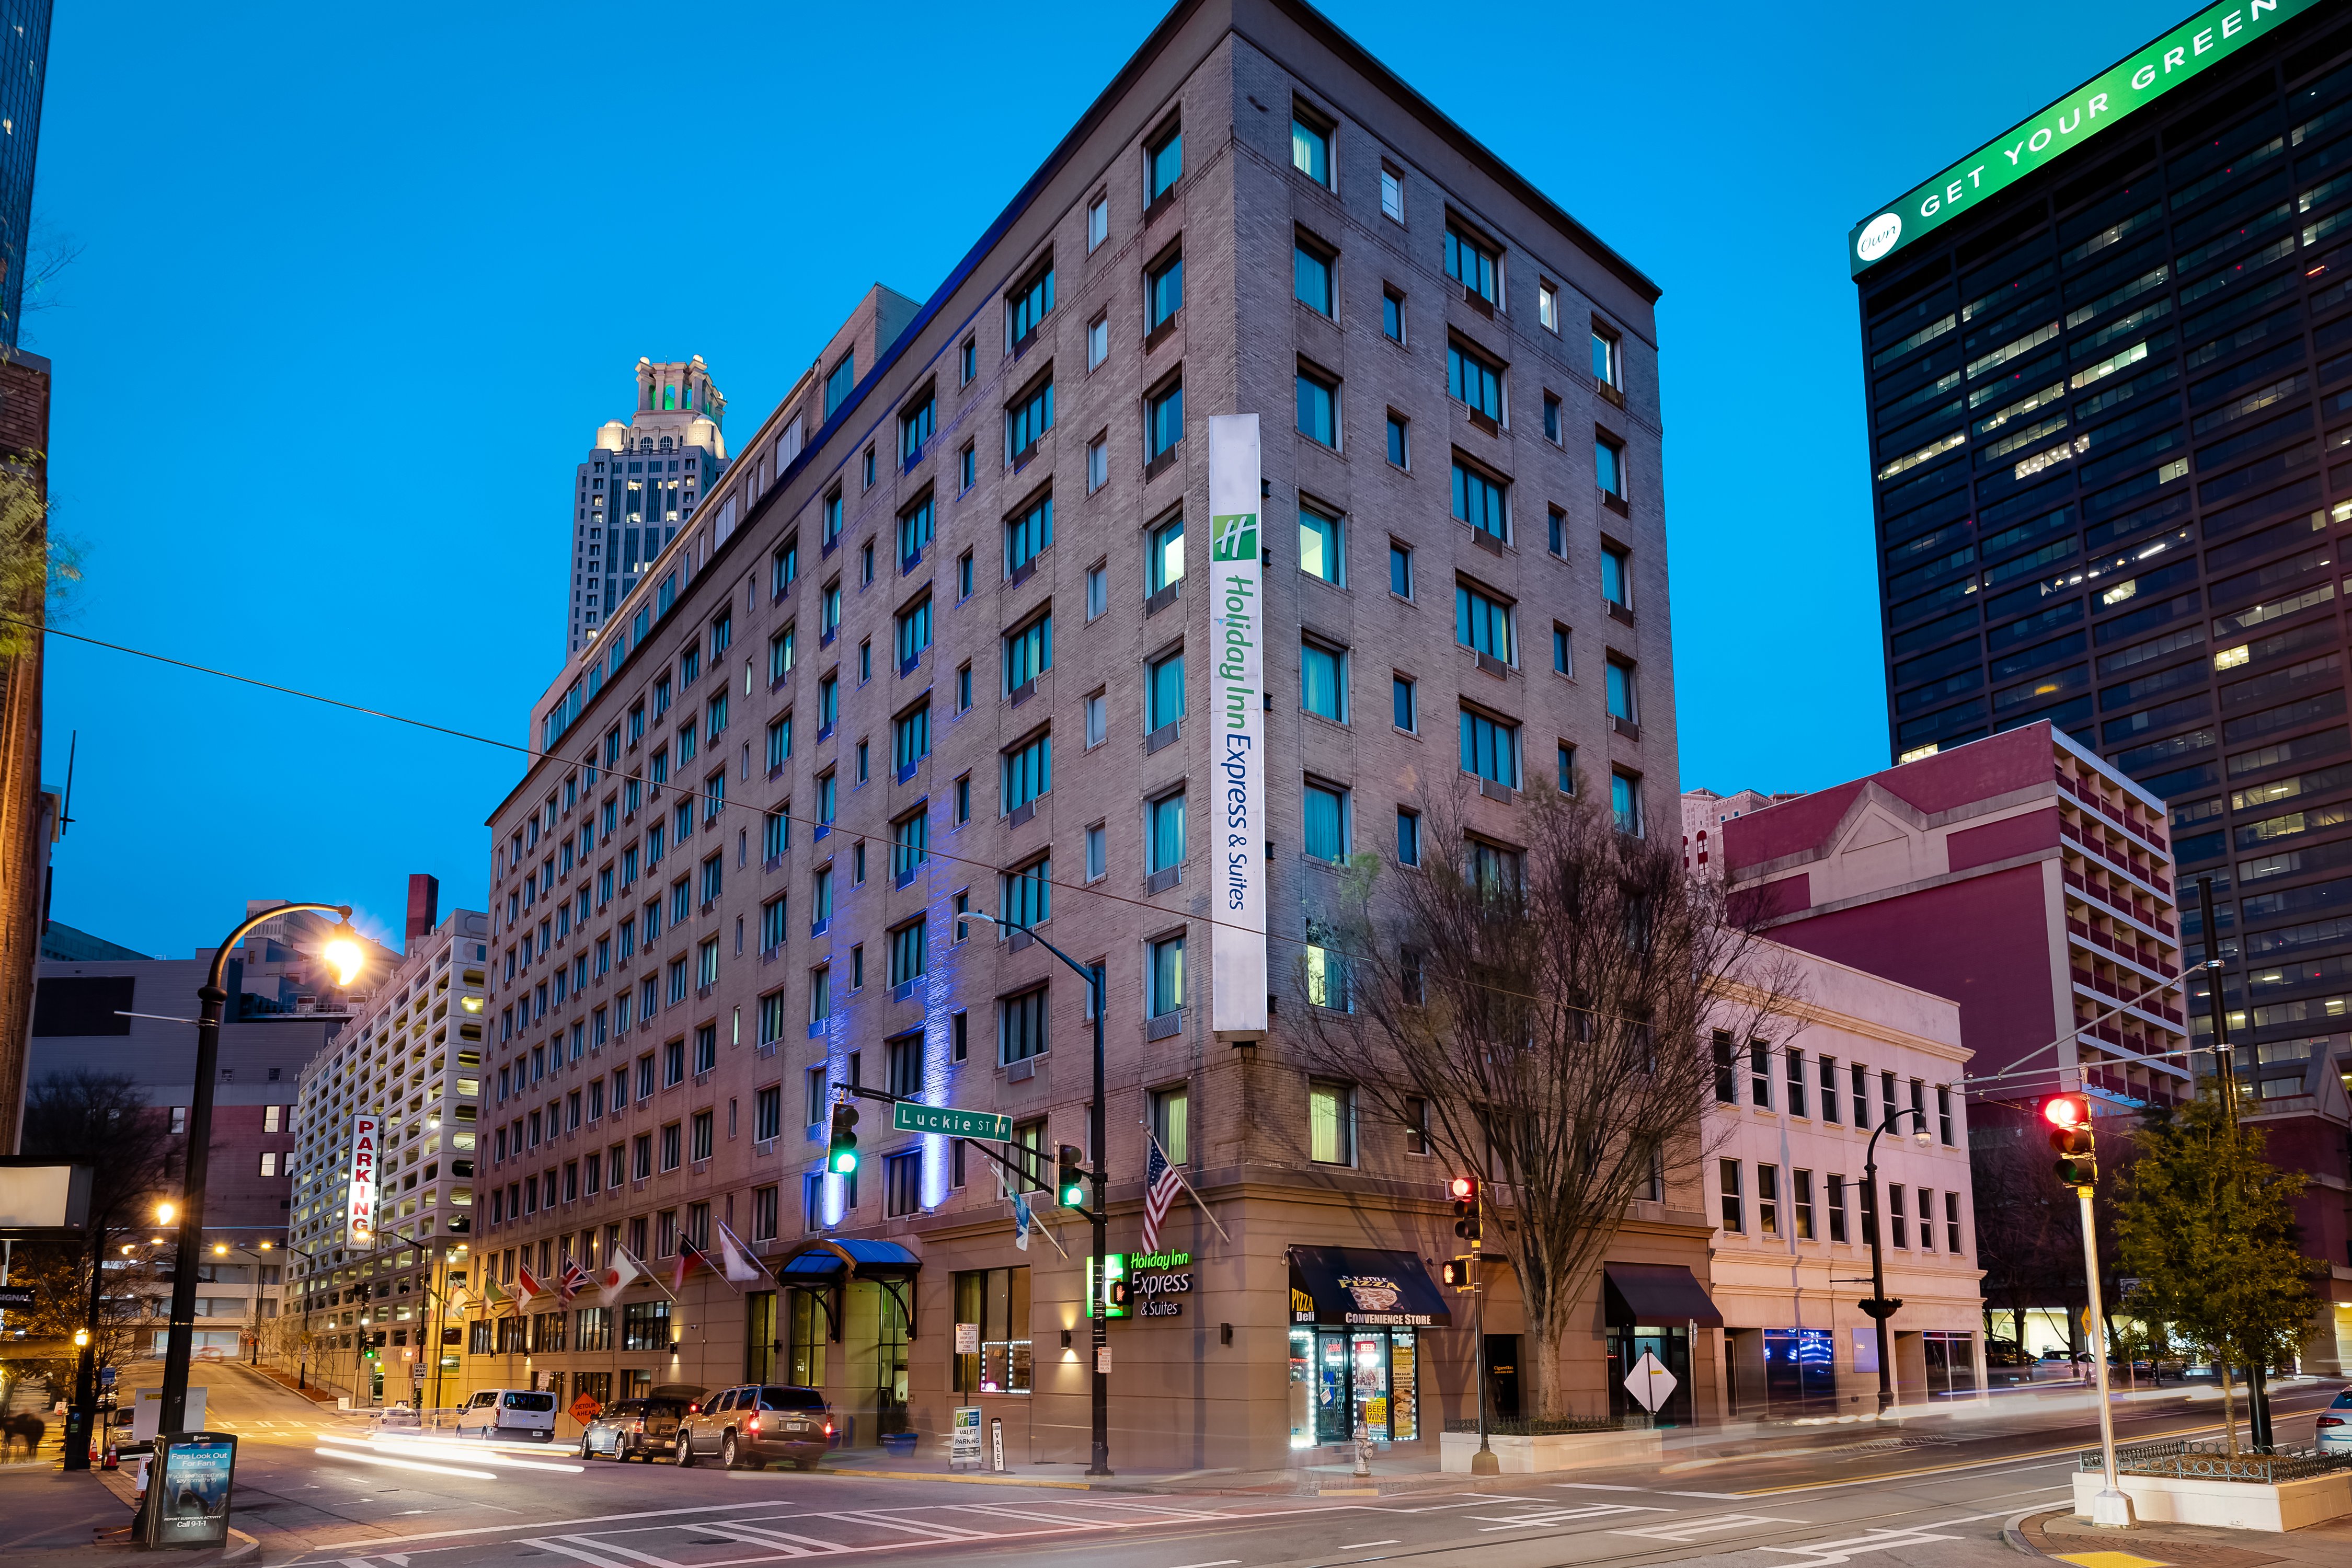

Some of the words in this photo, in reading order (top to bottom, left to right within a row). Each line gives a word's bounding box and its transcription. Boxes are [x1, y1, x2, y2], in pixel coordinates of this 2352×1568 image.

[1920, 165, 1986, 218] GET
[2004, 93, 2109, 165] YOUR
[2131, 0, 2277, 90] GREEN
[1861, 226, 1895, 252] Own
[1219, 574, 1254, 682] Holiday
[1226, 686, 1255, 729] Inn
[1220, 733, 1250, 829] Express
[1228, 834, 1247, 848] &
[1229, 853, 1247, 910] Suites
[902, 1109, 971, 1131] Luckie
[978, 1120, 990, 1132] ST
[995, 1122, 1006, 1134] NW
[352, 1120, 374, 1232] PARKING
[1130, 1251, 1170, 1270] Holiday
[1172, 1249, 1188, 1265] Inn
[1132, 1272, 1189, 1299] Express
[1337, 1279, 1402, 1292] PIZZA
[1141, 1301, 1148, 1316] &
[1149, 1301, 1177, 1316] Suites
[1292, 1287, 1314, 1311] PIZZA
[1297, 1311, 1314, 1321] Deli
[1346, 1312, 1403, 1324] CONVENIENCE
[1405, 1314, 1431, 1324] STORE
[1360, 1343, 1374, 1352] BEER
[1368, 1413, 1386, 1421] WINE
[1368, 1421, 1386, 1429] CIGARETTE
